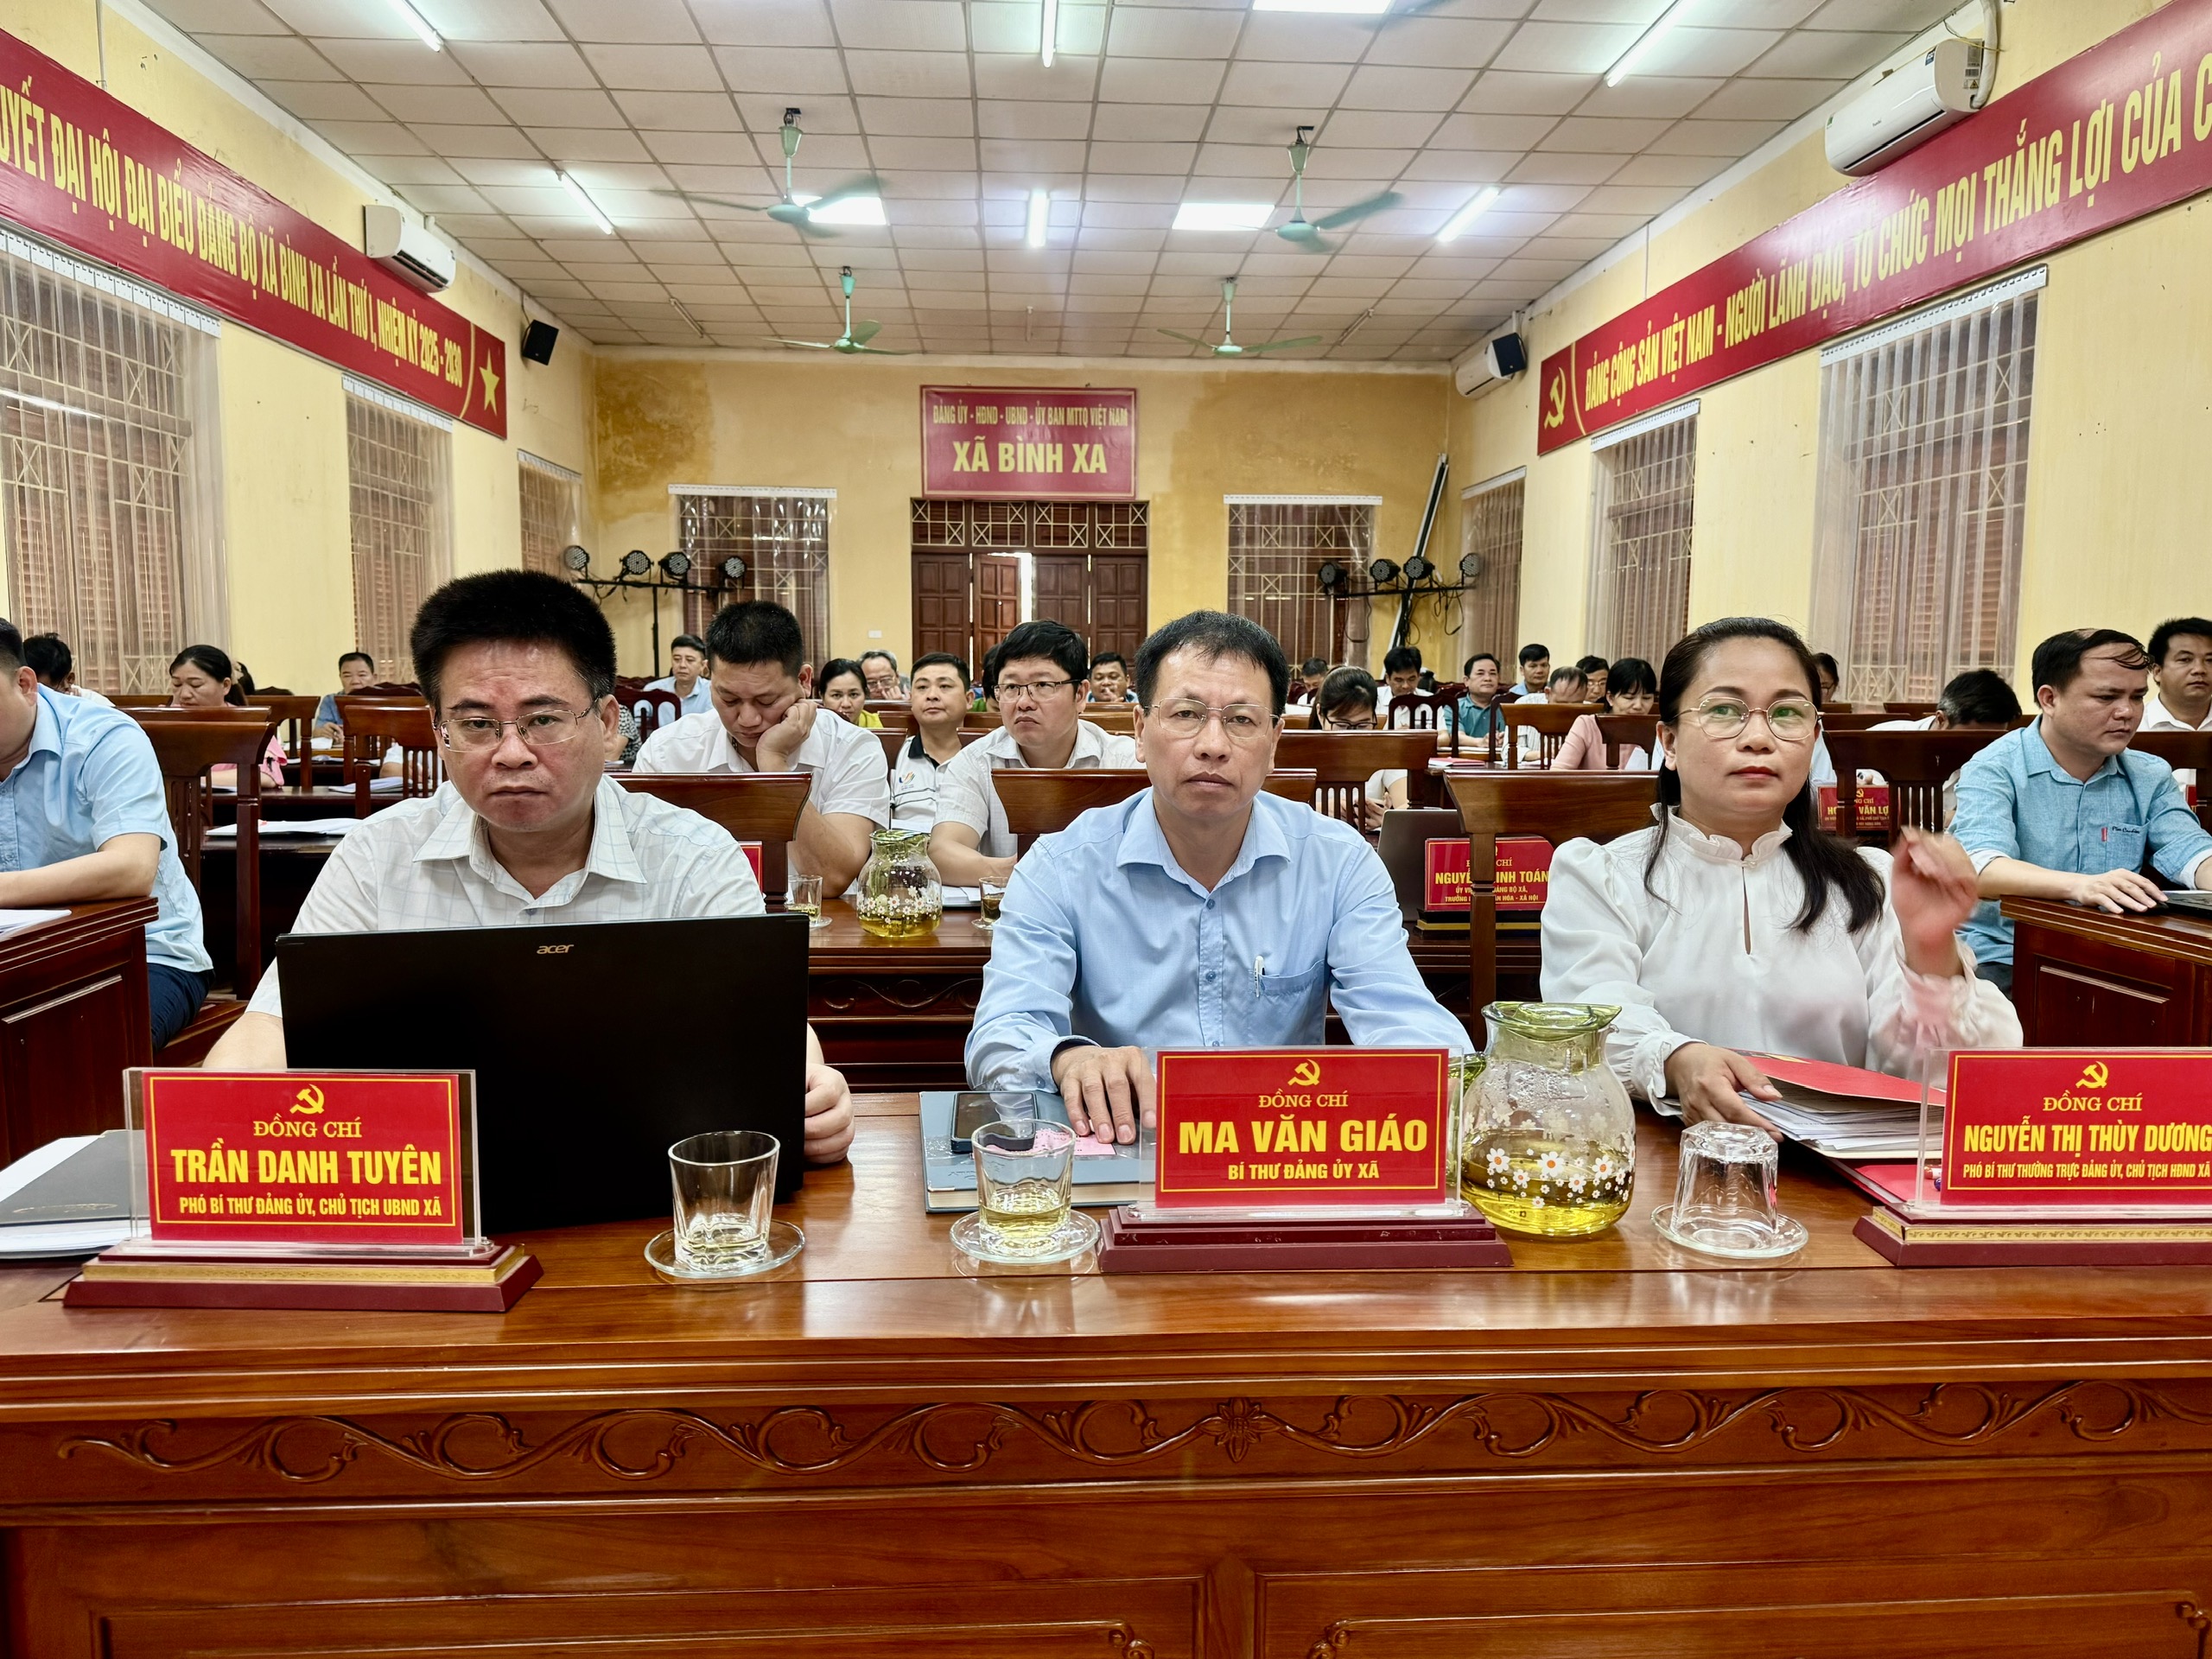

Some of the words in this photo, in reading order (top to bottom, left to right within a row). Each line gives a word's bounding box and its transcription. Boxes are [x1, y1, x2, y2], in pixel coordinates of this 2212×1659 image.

[1585, 351, 1609, 411] ĐẢNG
[1611, 341, 1636, 406] CỘNG
[1636, 320, 1660, 386] SẢN
[1662, 312, 1686, 382] VIỆT
[1686, 304, 1715, 365] NAM
[1725, 268, 1766, 348] NGƯỜI
[1769, 257, 1808, 329] LÃNH
[1878, 188, 1929, 281] CHỨC
[1934, 172, 1977, 263] MỌI
[1984, 118, 2063, 235] THẮNG
[2069, 99, 2113, 207] LỢI
[2121, 50, 2182, 174] CỦA
[50, 113, 86, 214] ĐẠI
[89, 128, 122, 231] HỘI
[124, 155, 155, 247] ĐẠI
[157, 158, 194, 255] BIỂU
[196, 181, 237, 276] ĐẢNG
[238, 213, 257, 300] BỘ
[259, 226, 278, 297] XÃ
[279, 234, 308, 311] BÌNH
[309, 260, 326, 320] XA
[327, 256, 347, 331] LẦN
[348, 278, 368, 340] THỨ
[377, 297, 407, 366] NHIỆM
[407, 308, 418, 365] KỲ
[420, 323, 439, 377] 2025
[445, 338, 462, 388] 2030
[933, 398, 956, 424] ĐẢNG
[1005, 406, 1027, 425] UBND
[1047, 407, 1065, 426] BAN
[1067, 407, 1088, 429] MTTQ
[1090, 404, 1107, 430] VIỆT
[1109, 407, 1128, 427] NAM
[952, 435, 990, 472] XÃ
[998, 435, 1064, 474] BÌNH
[1071, 443, 1108, 474] XA
[1496, 857, 1512, 867] CHÍ
[1497, 871, 1516, 883] INH
[537, 944, 575, 955] acer
[1258, 1088, 1312, 1108] ĐỒNG
[1316, 1090, 1348, 1107] CHÍ
[2043, 1090, 2101, 1111] ĐỒNG
[2107, 1092, 2143, 1111] CHÍ
[253, 1113, 317, 1138] ĐỒNG
[323, 1116, 362, 1138] CHÍ
[1179, 1122, 1239, 1154] MA
[1251, 1114, 1326, 1153] VĂN
[1340, 1113, 1427, 1152] GIÁO
[1964, 1116, 2045, 1152] NGUYỄN
[2051, 1125, 2083, 1157] THỊ
[2088, 1120, 2140, 1152] THÙY
[2144, 1122, 2212, 1152] DƯƠNG
[171, 1137, 248, 1183] TRẦN
[259, 1151, 338, 1184] DANH
[347, 1144, 442, 1185] TUYÊN
[1228, 1161, 1244, 1180] BÍ
[1249, 1162, 1281, 1179] THƯ
[1284, 1160, 1327, 1179] ĐẢNG
[1333, 1159, 1354, 1179] ỦY
[1357, 1160, 1379, 1179] XÃ
[1963, 1161, 1983, 1178] PHÓ
[1985, 1161, 1995, 1178] BÍ
[1997, 1162, 2016, 1178] THƯ
[2017, 1160, 2053, 1178] THƯỜNG
[2056, 1162, 2080, 1181] TRỰC
[2082, 1160, 2107, 1178] ĐẢNG
[2110, 1160, 2123, 1179] ỦY,
[2126, 1160, 2145, 1178] CHỦ
[2147, 1164, 2168, 1180] TỊCH
[2170, 1164, 2196, 1178] HĐND
[2197, 1161, 2210, 1178] XÃ
[180, 1193, 206, 1214] PHÓ
[211, 1193, 224, 1214] BÍ
[227, 1196, 254, 1214] THƯ
[256, 1192, 293, 1215] ĐẢNG
[296, 1192, 316, 1217] ỦY,
[319, 1192, 346, 1215] CHỦ
[349, 1198, 379, 1218] TỊCH
[384, 1198, 419, 1216] UBND
[423, 1197, 442, 1216] XÃ
